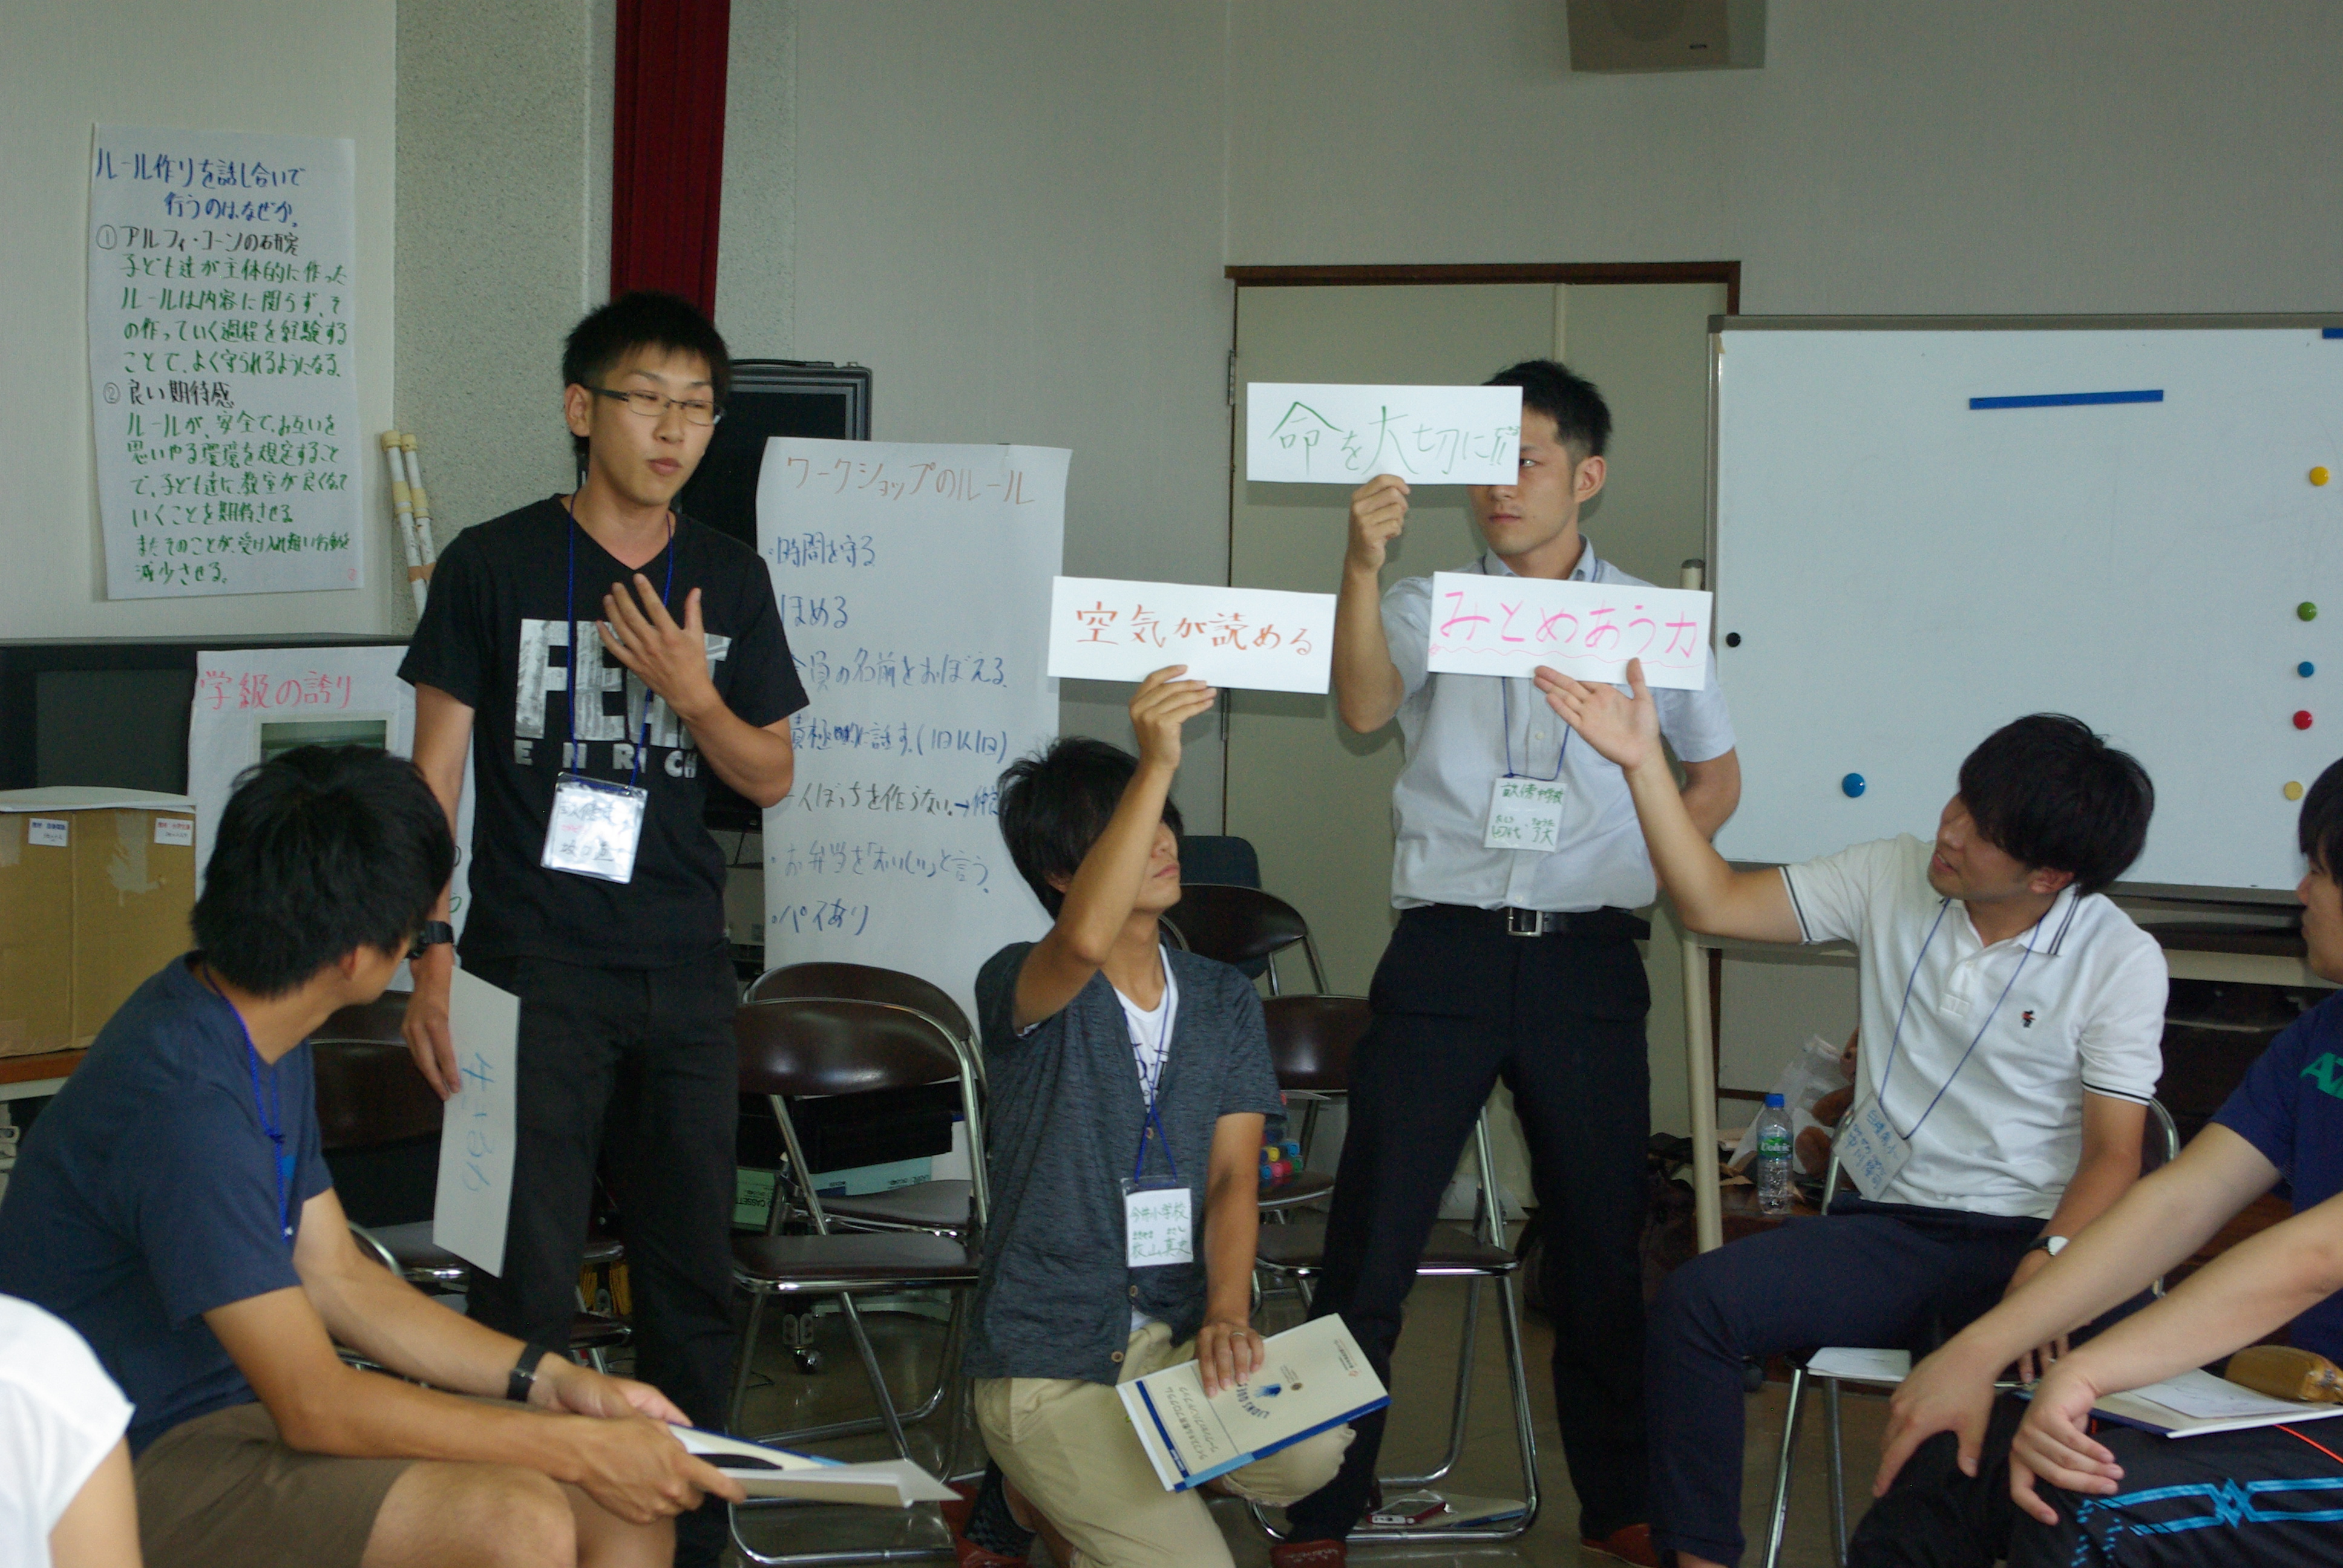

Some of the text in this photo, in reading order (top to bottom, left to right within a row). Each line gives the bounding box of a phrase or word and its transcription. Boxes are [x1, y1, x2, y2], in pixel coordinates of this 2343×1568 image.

[96, 148, 306, 189] ルール作りを話し合いで
[120, 253, 347, 286] 子ども達が主体的に作った
[124, 318, 347, 345] の作っていく過程を経験する
[128, 379, 235, 408] 良い期待感
[787, 457, 1035, 505] ワークショップのルール
[1076, 601, 1312, 656] 空気が読める
[1439, 591, 1697, 658] みとめあう力
[200, 670, 352, 710] 学級の誇り
[1236, 1381, 1250, 1402] QUES
